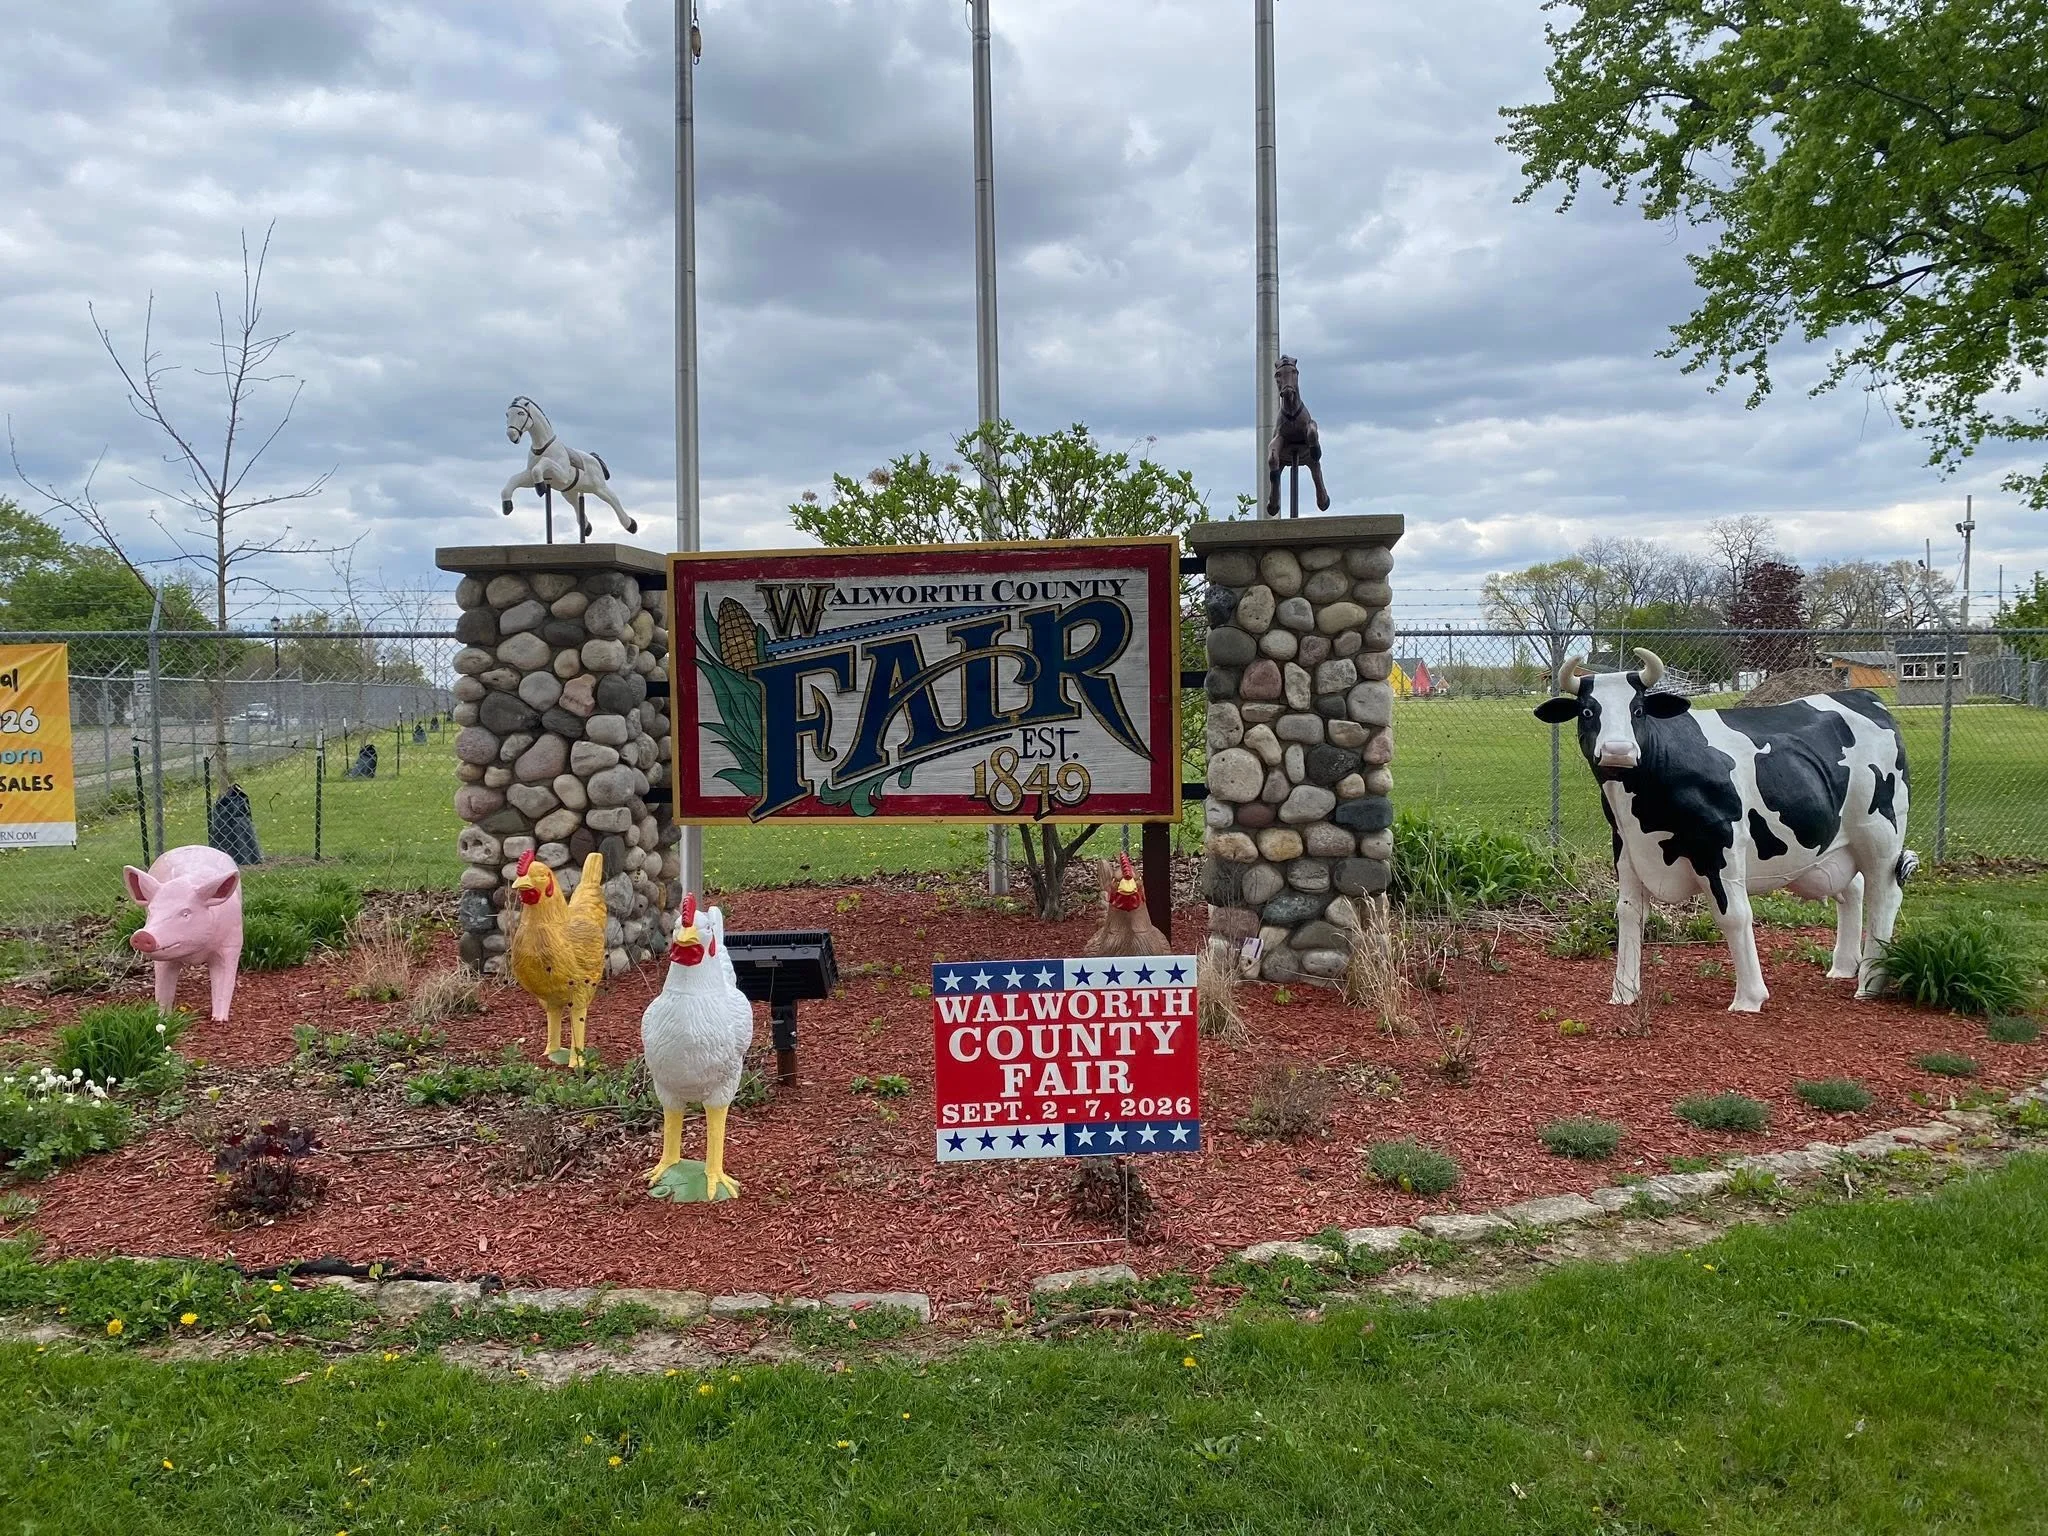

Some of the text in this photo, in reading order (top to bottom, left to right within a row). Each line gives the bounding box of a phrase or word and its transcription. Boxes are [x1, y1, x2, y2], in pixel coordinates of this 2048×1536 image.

[755, 578, 1130, 638] WALWORTH COUNTY
[0, 705, 40, 734] 26
[747, 596, 1155, 822] FAIR
[969, 745, 1092, 821] 1849
[936, 988, 1194, 1024] WALWORTH
[948, 1021, 1181, 1062] COUNTY
[999, 1060, 1134, 1098] FAIR
[942, 1101, 1031, 1124] SEPT.
[1120, 1097, 1192, 1117] 2026
